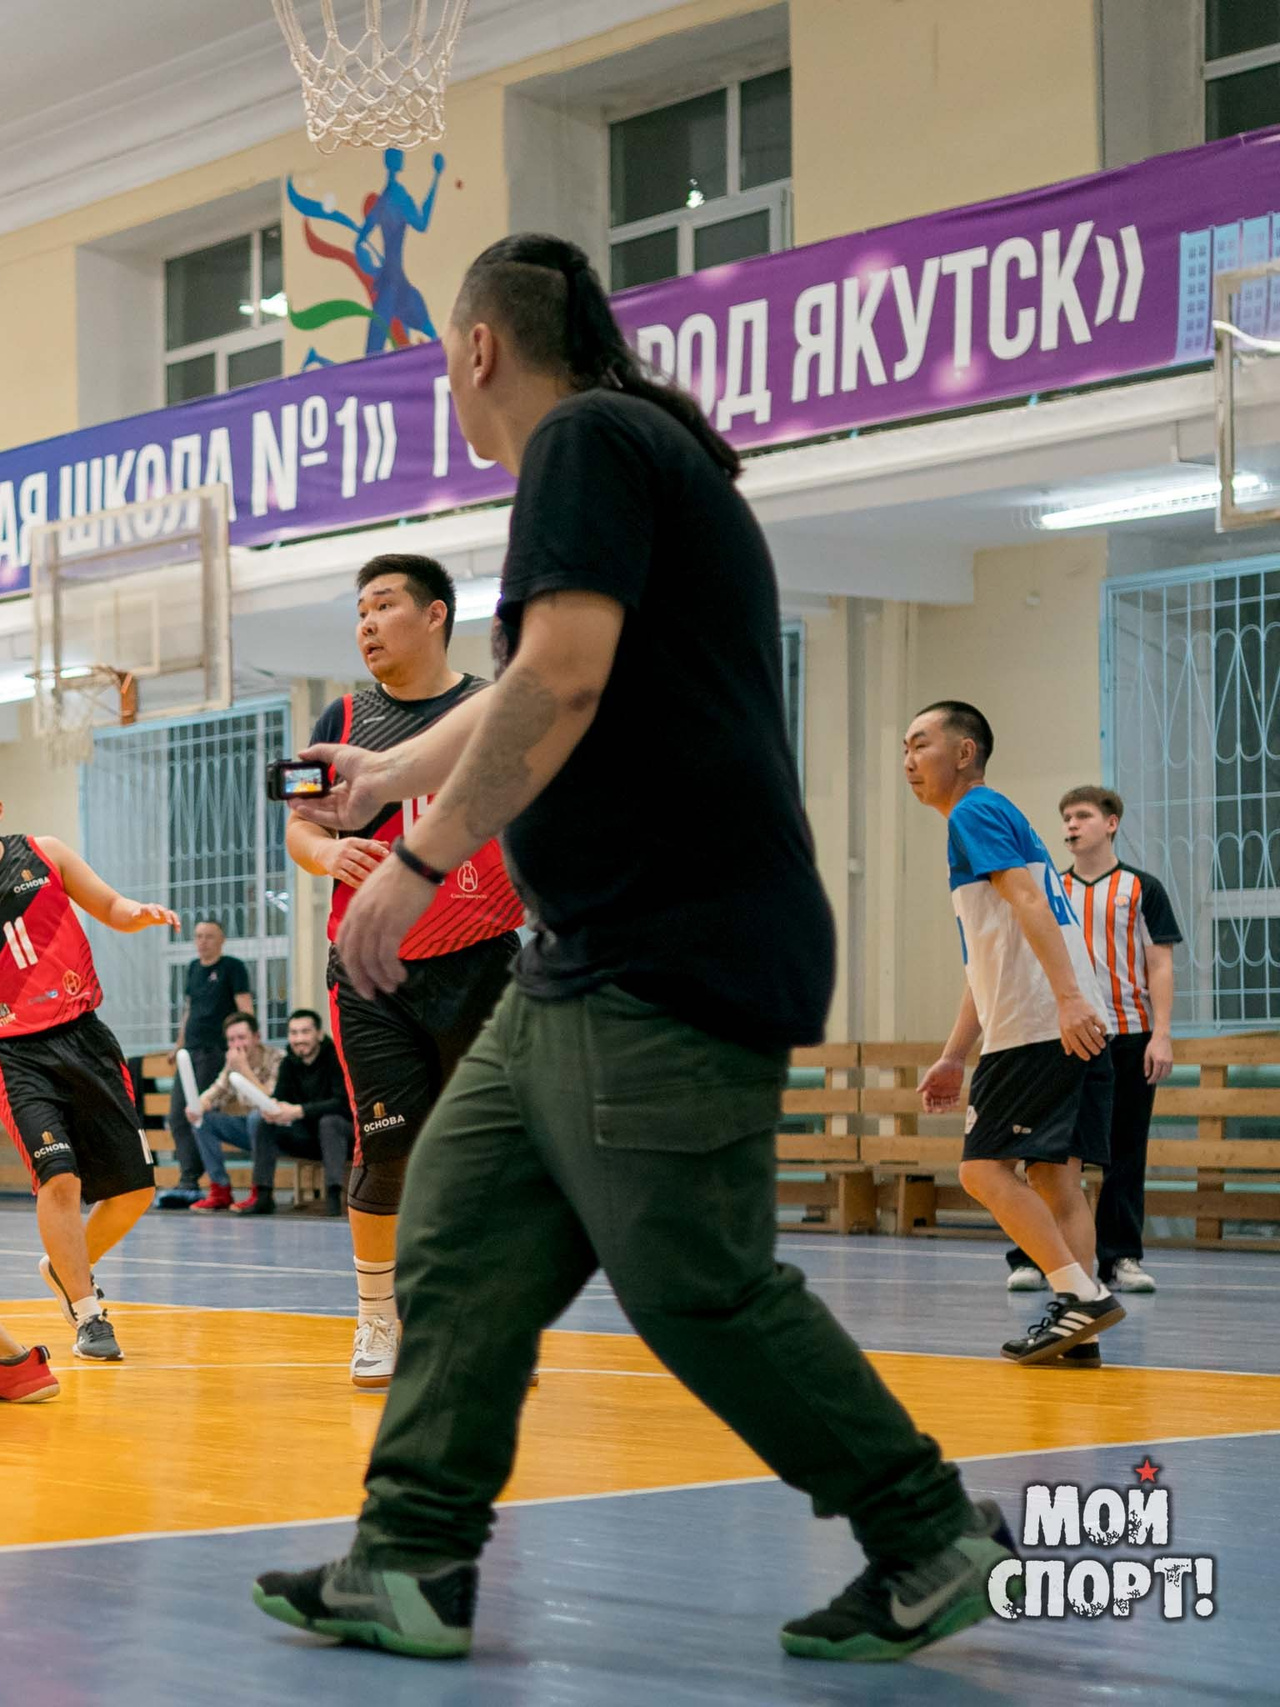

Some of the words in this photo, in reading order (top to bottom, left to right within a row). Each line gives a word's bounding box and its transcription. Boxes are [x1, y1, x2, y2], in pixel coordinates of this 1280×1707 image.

[59, 427, 237, 556] ШКОЛА
[792, 220, 1145, 403] ЯКУТСК»
[3, 916, 39, 970] 11
[363, 1114, 405, 1132] ОСНОВА
[33, 1142, 71, 1159] ОСНОВА
